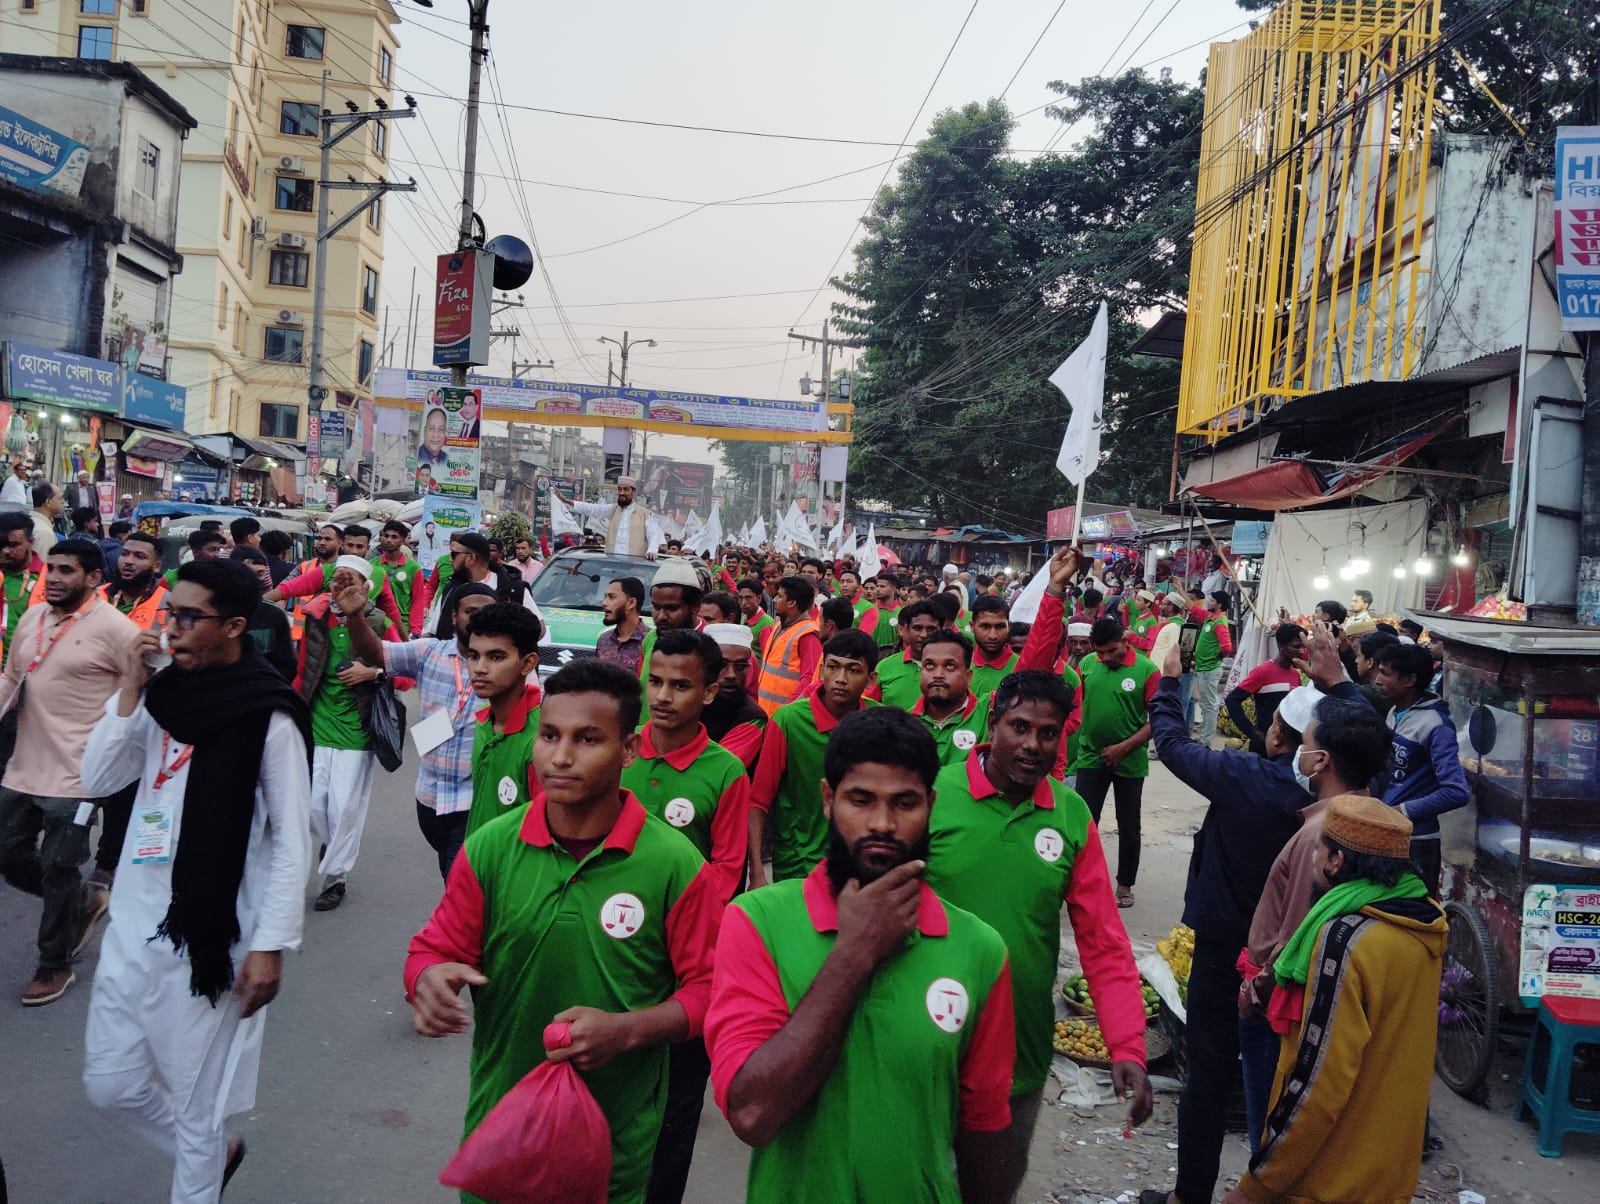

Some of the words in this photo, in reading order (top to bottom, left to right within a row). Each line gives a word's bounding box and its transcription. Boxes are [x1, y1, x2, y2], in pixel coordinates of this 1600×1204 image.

[438, 278, 469, 305] Fiza
[18, 353, 62, 377] হোসেন
[65, 363, 94, 385] খেলা
[96, 368, 114, 388] ঘর
